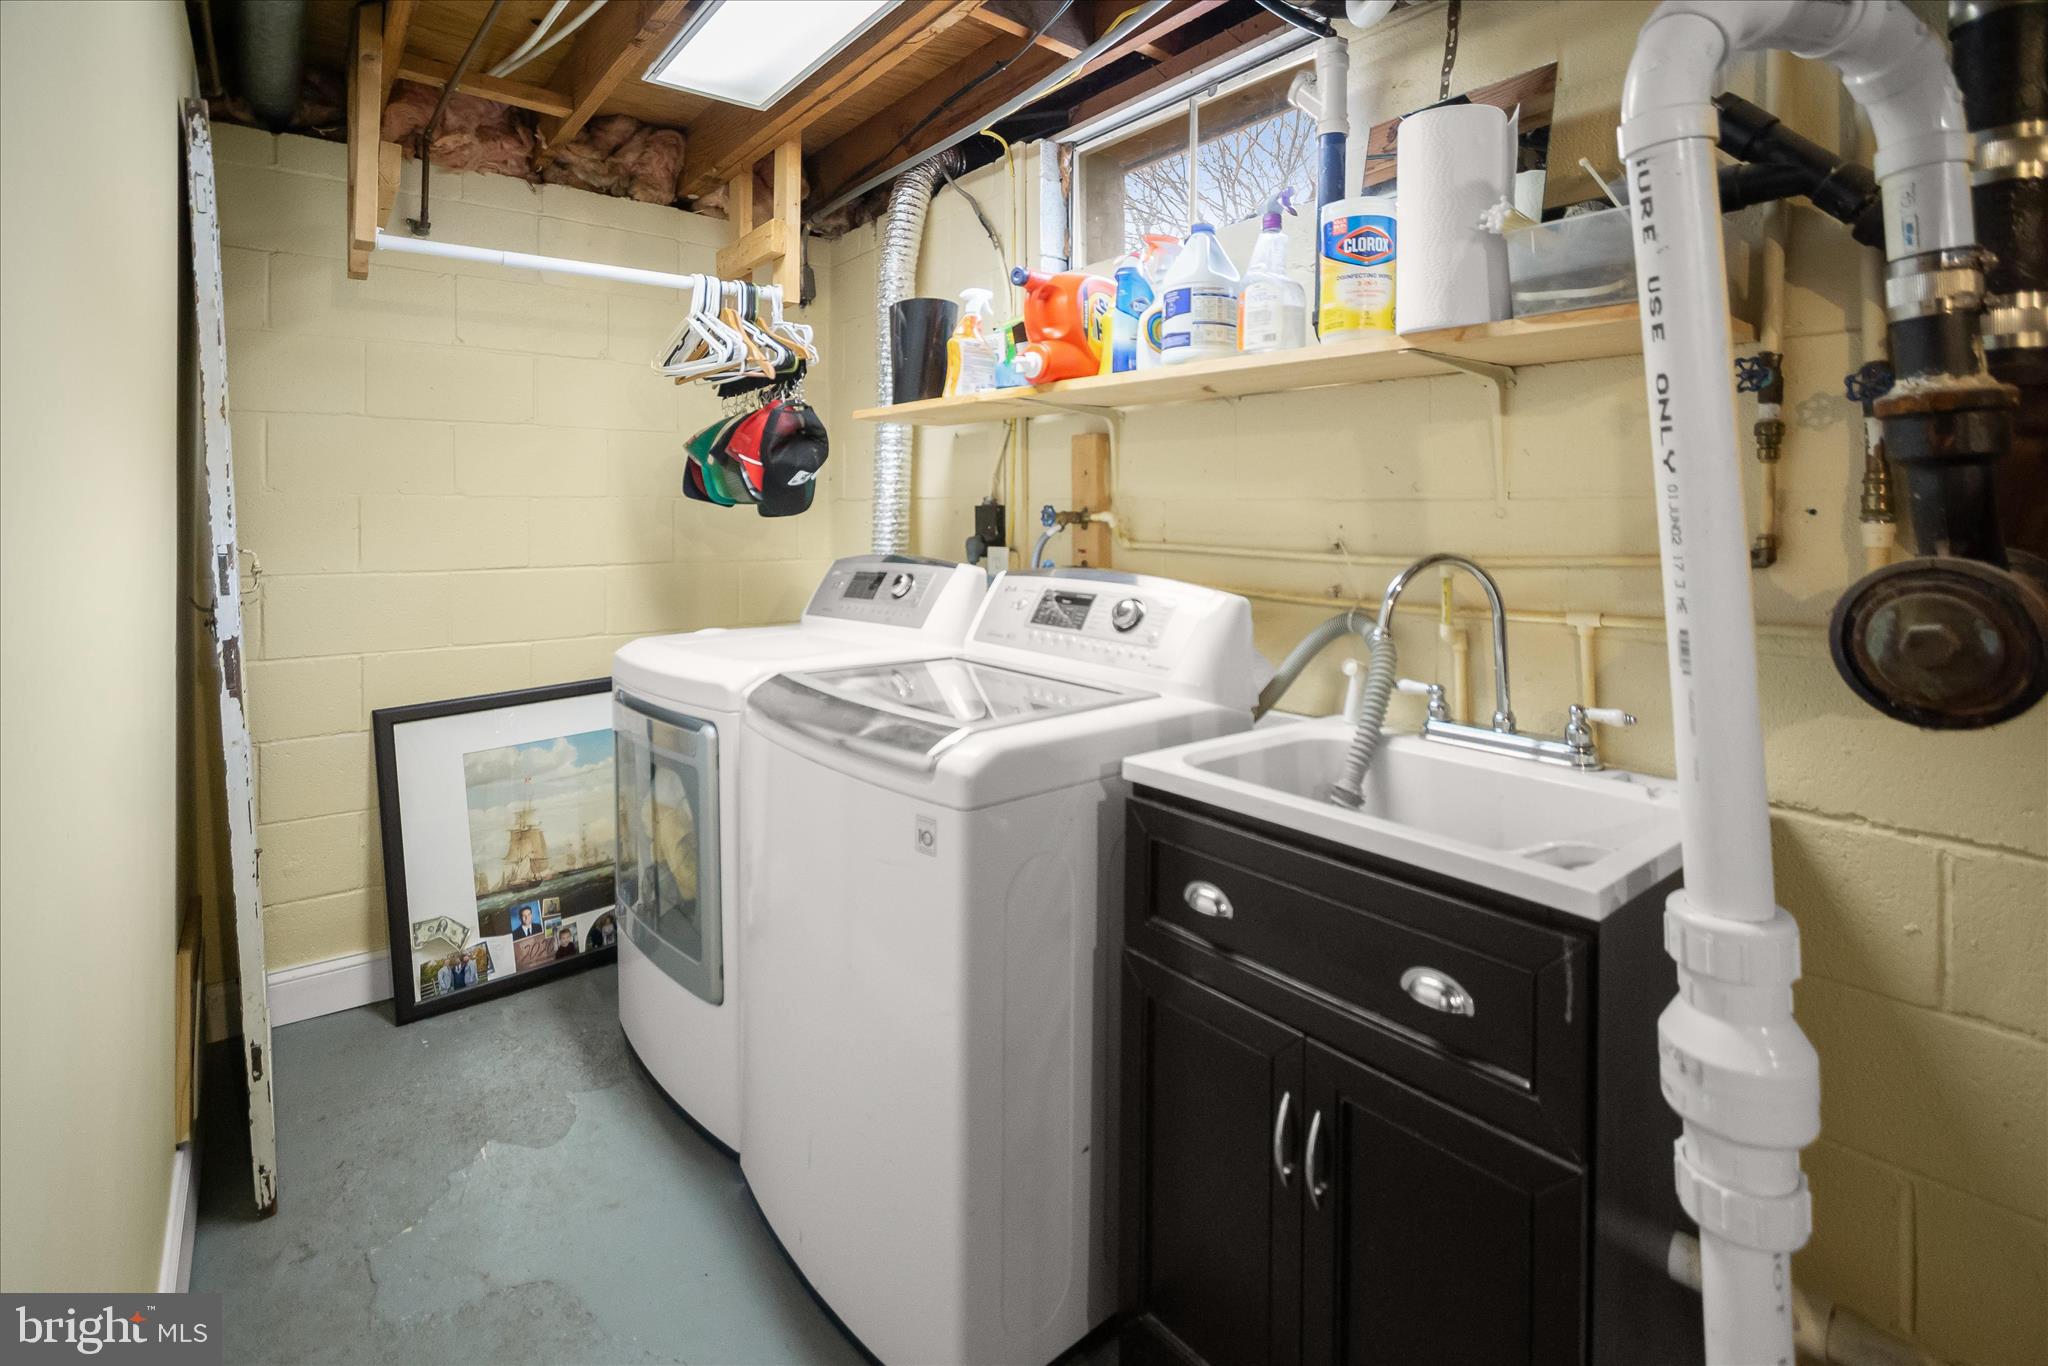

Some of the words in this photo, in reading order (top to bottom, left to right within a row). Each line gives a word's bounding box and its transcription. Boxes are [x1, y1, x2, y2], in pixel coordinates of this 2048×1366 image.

[1635, 158, 1657, 245] URE
[1343, 236, 1389, 253] CLOROX
[1647, 275, 1666, 343] USE
[1655, 372, 1677, 474] ONLY
